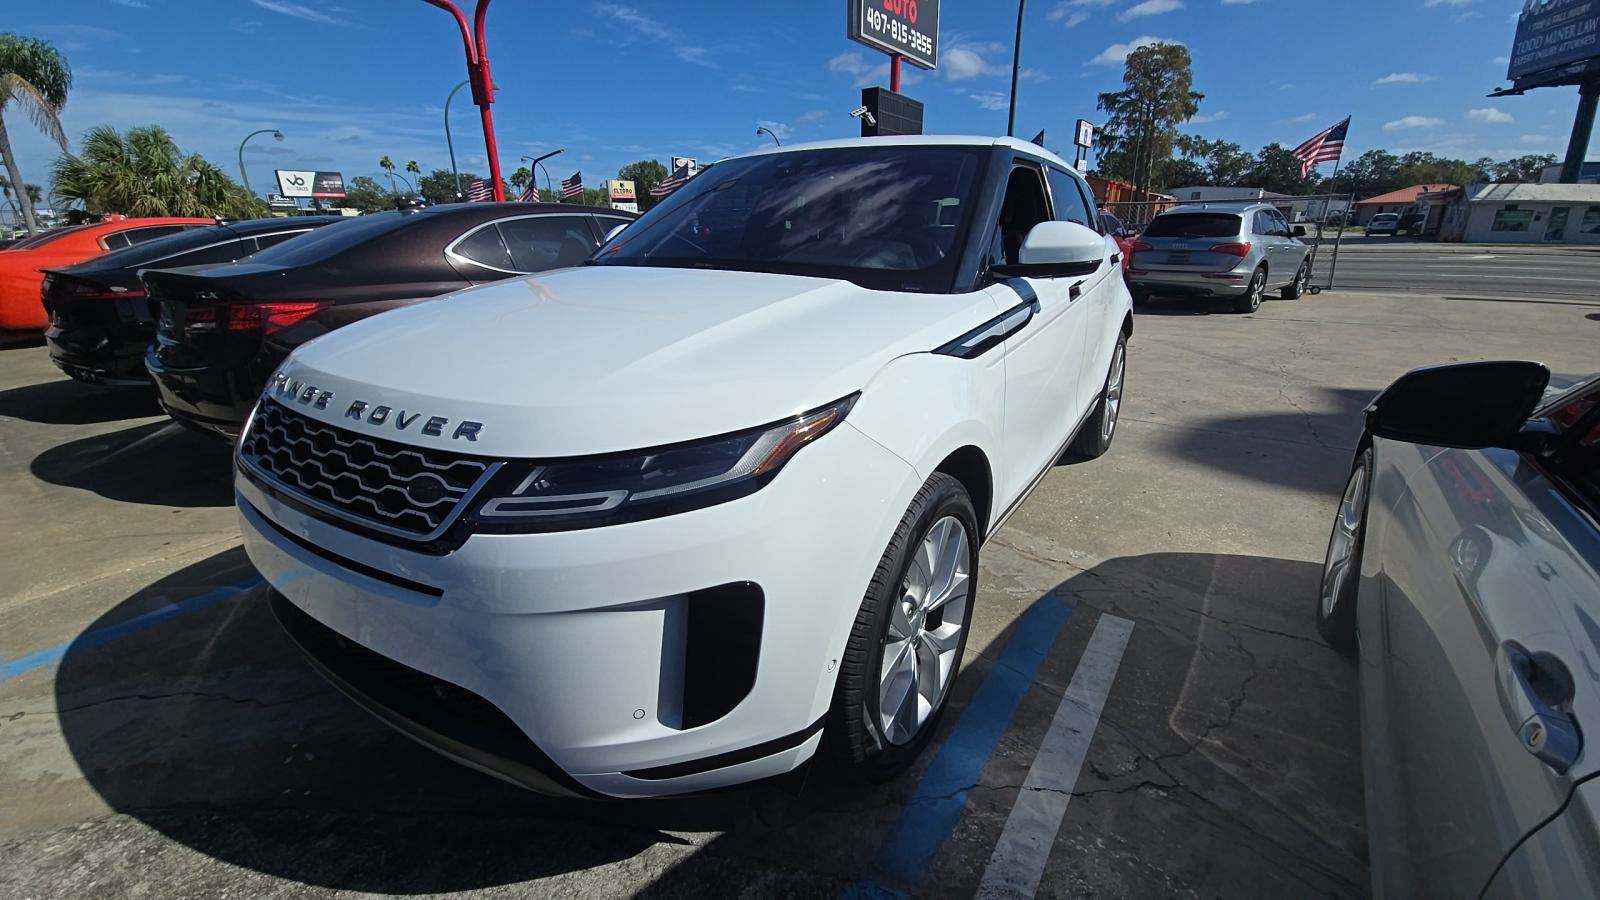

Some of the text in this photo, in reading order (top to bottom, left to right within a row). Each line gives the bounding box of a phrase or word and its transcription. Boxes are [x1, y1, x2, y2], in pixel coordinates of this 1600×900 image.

[867, 7, 932, 55] 407-815-3255
[1517, 36, 1543, 55] TODD
[344, 399, 486, 442] ROVER
